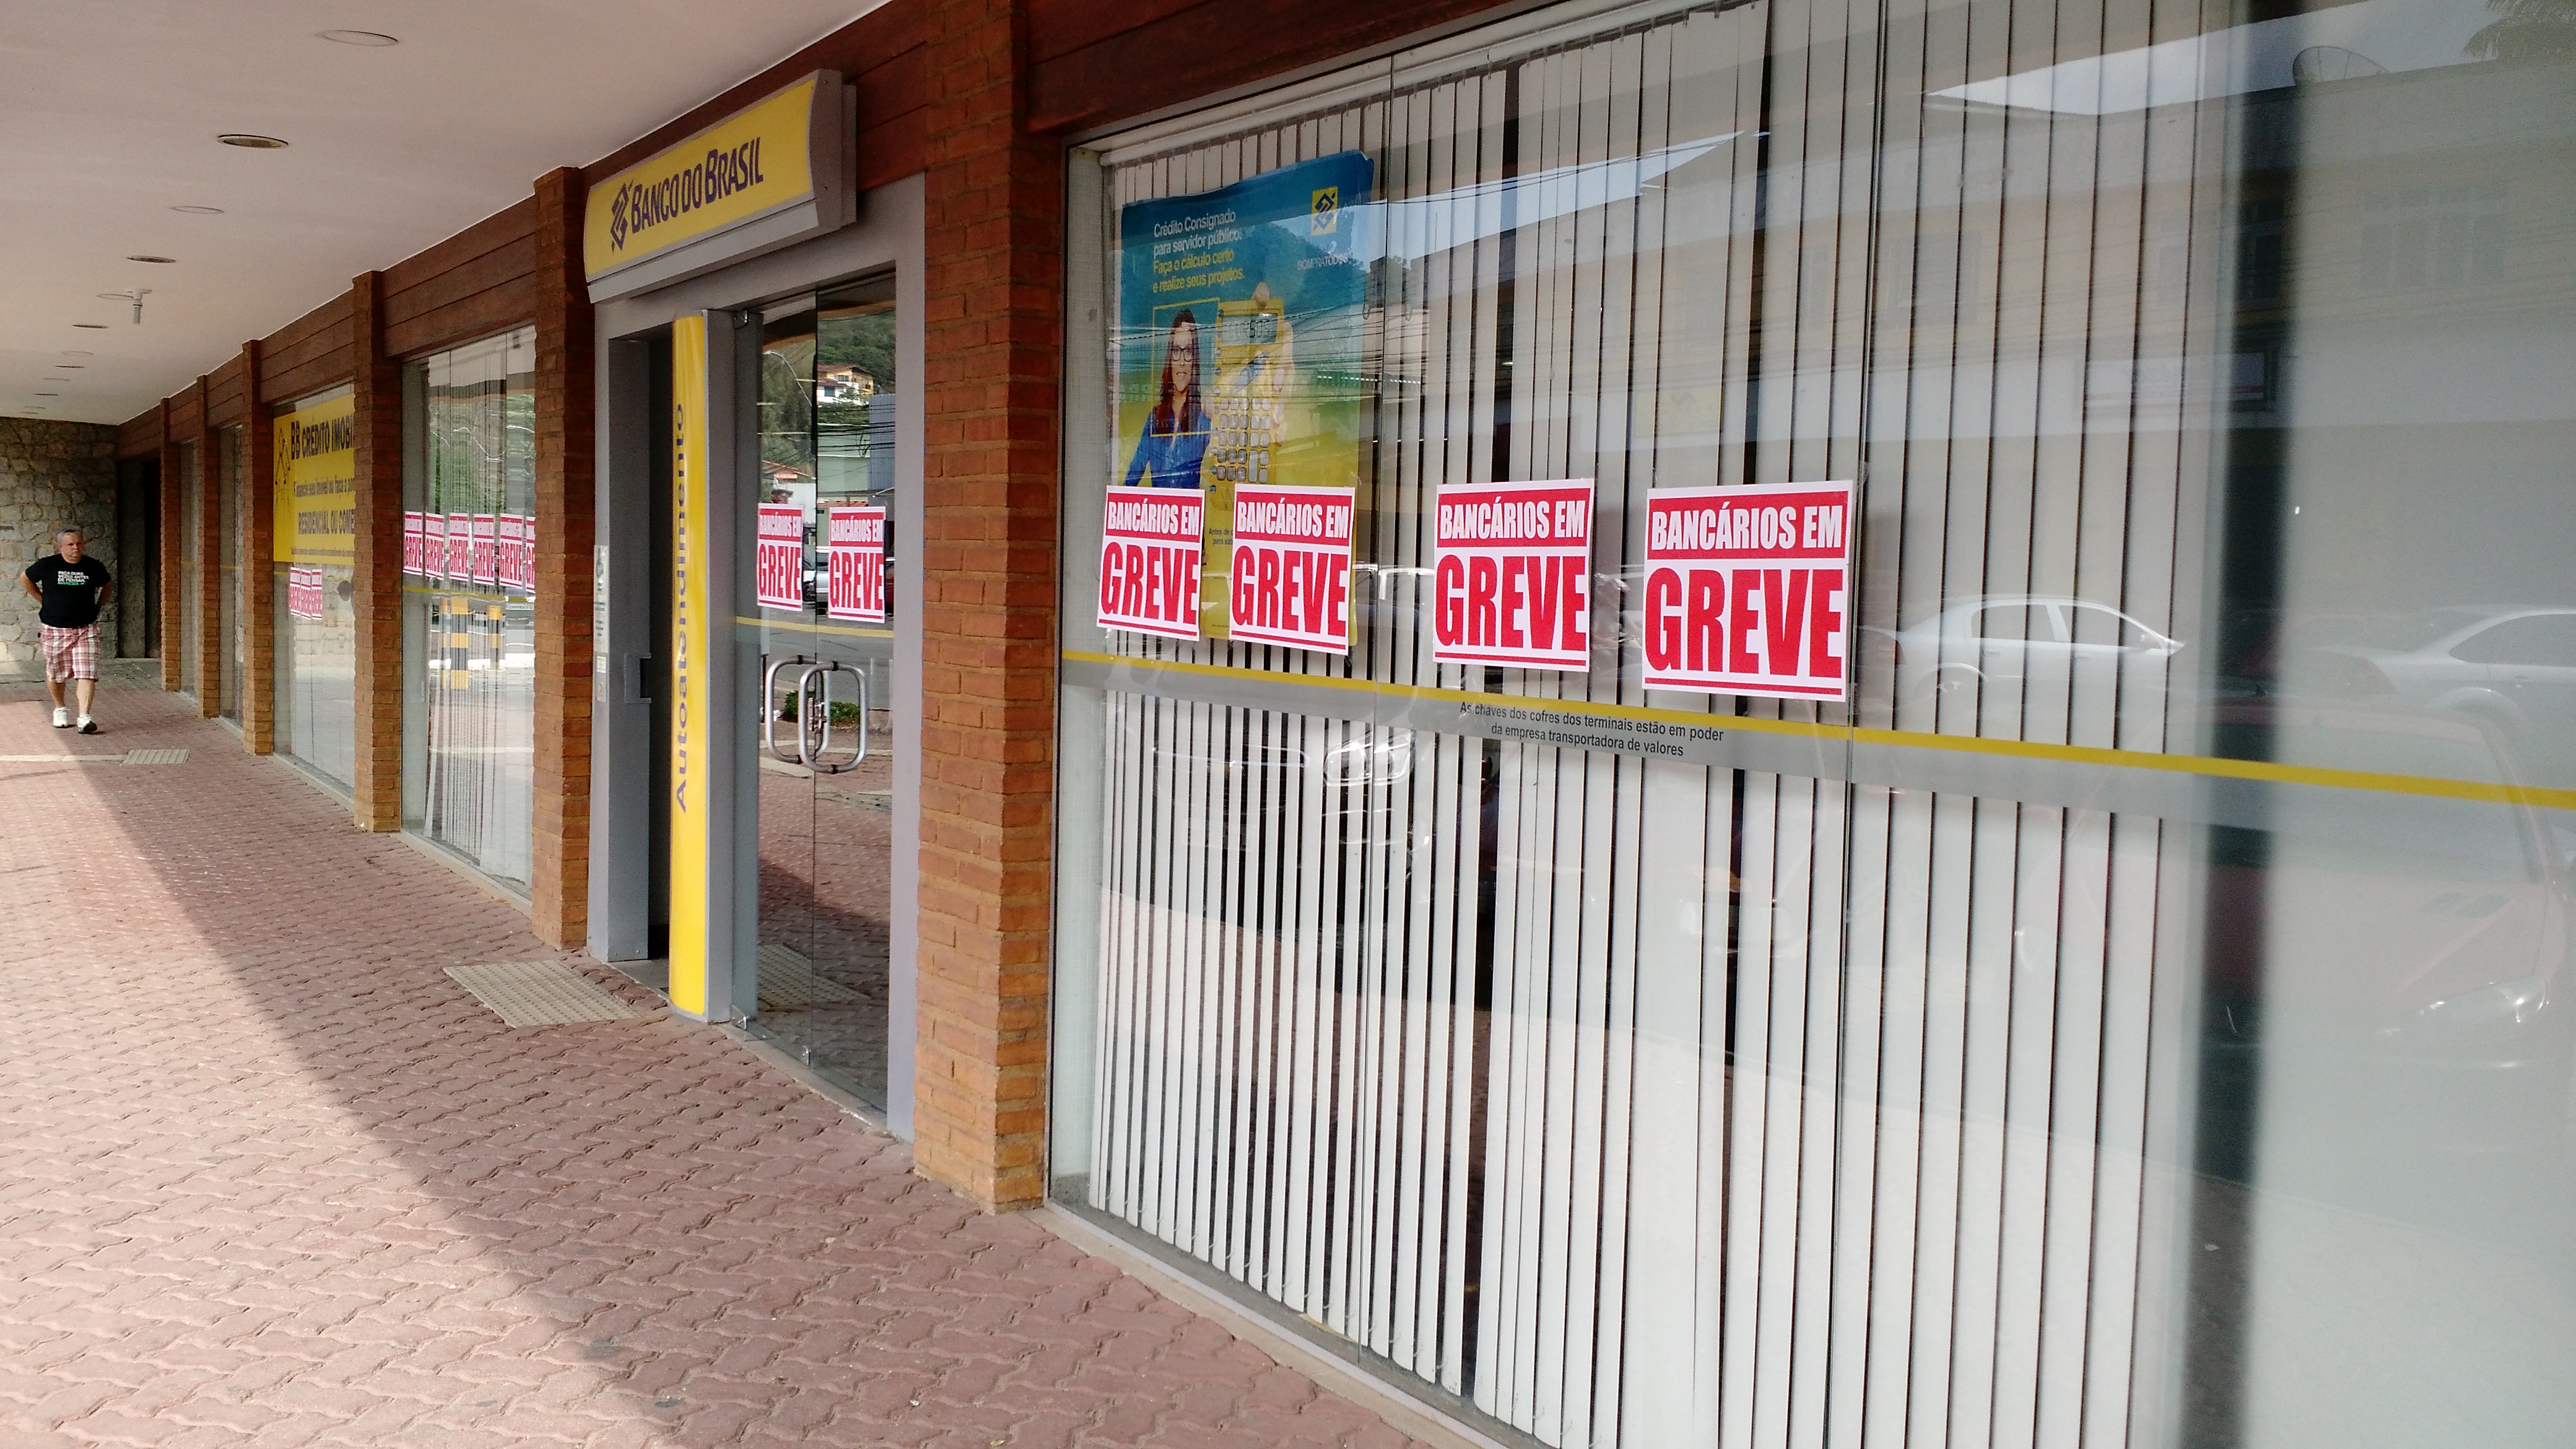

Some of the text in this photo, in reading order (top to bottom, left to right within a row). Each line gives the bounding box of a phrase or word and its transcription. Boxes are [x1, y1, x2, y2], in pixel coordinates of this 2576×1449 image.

[631, 137, 764, 234] BANCO DO BRASIL
[1154, 208, 1237, 238] Crédito Consignado
[1154, 227, 1242, 259] para servidor público.
[1152, 267, 1245, 293] e realize seus projetos.
[1153, 248, 1235, 277] Faça o cálculo certo
[291, 420, 300, 460] BB
[759, 511, 802, 537] BANCÁRIOS EM
[830, 515, 883, 542] BANCÁRIOS EM
[1107, 498, 1200, 537] BANCÁRIOS EM
[1237, 497, 1349, 538] BANCÁRIOS EM
[1440, 496, 1586, 539] BANCÁRIOS EM
[1651, 501, 1843, 551] BANCÁRIOS EM
[450, 539, 469, 575] GREVE
[474, 541, 494, 578] GREVE
[500, 541, 522, 582] GREVE
[759, 544, 801, 600] GREVE
[829, 550, 884, 611] GREVE
[1101, 541, 1199, 625] GREVE
[1232, 545, 1349, 637] GREVE
[676, 403, 687, 814] Autoatendimento
[1435, 554, 1587, 651] GREVE
[1644, 567, 1843, 678] GREVE
[1460, 701, 1725, 741] As chaves dos cofres dos terminais estão em poder
[1491, 723, 1684, 756] da empresa transportadora de valores
